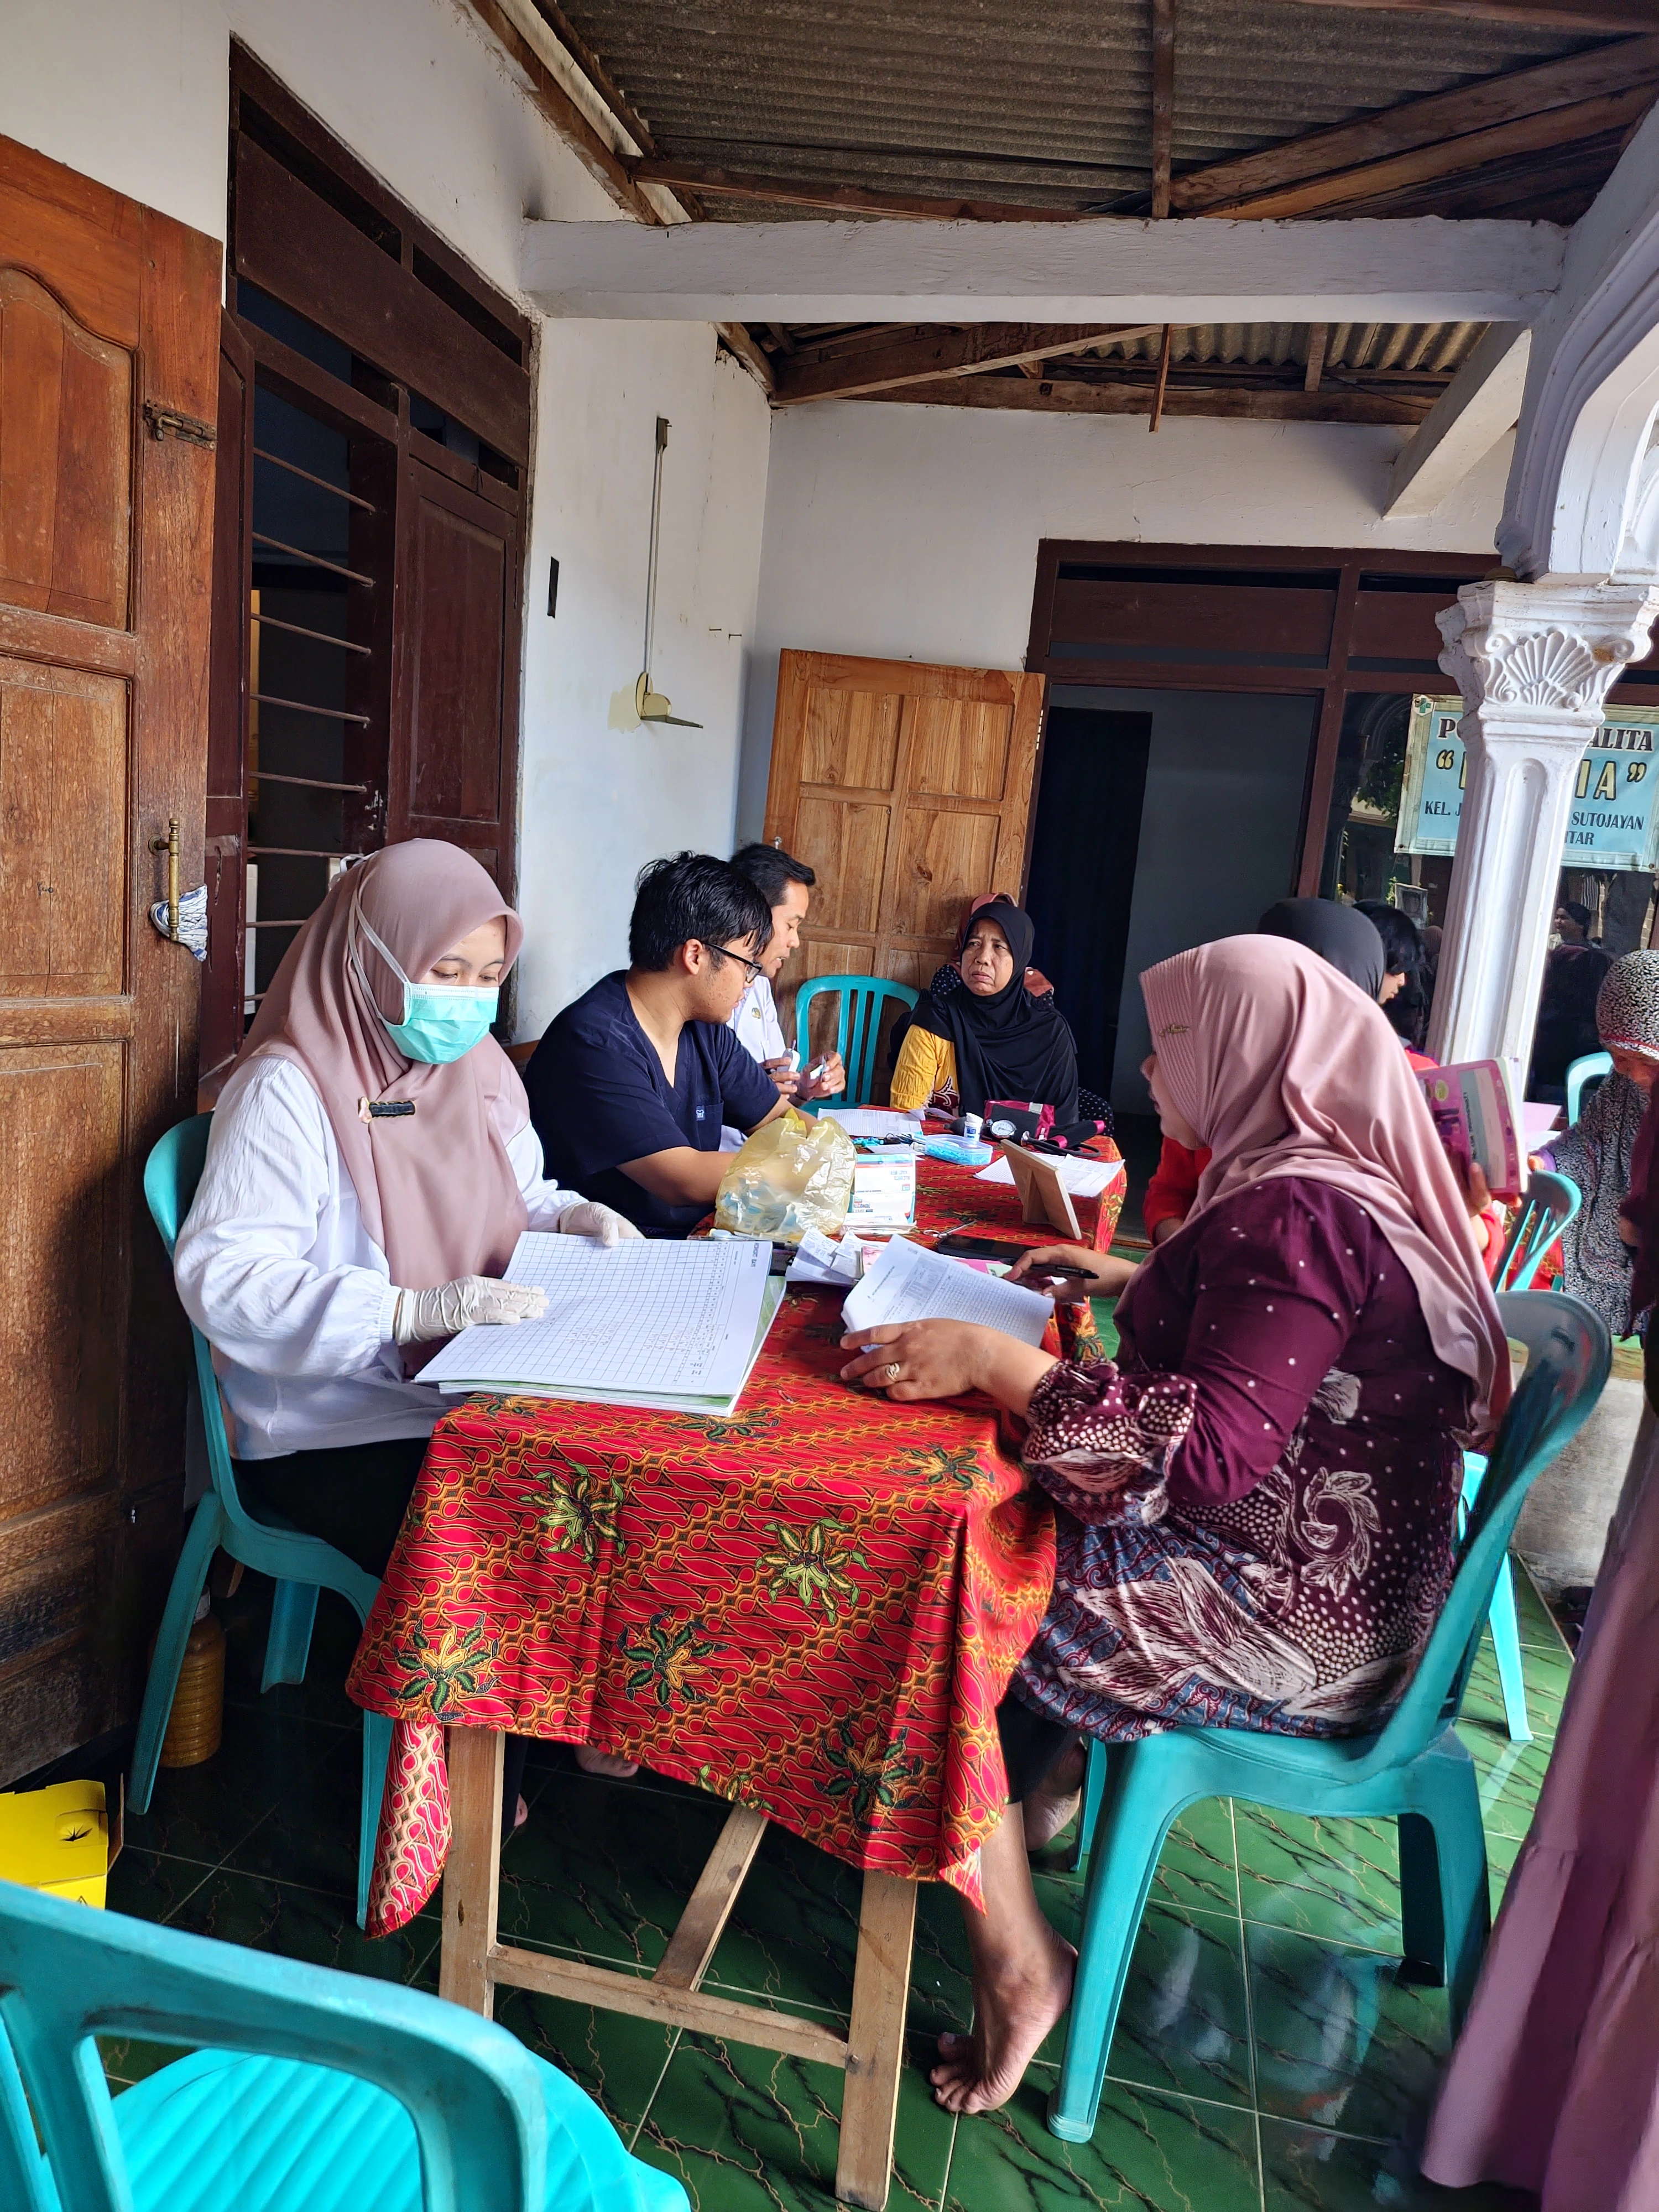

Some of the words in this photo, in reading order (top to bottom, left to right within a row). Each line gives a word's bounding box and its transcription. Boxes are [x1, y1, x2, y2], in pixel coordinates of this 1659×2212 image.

[1589, 727, 1652, 752] ALITA
[1425, 801, 1451, 816] KEL.
[1572, 811, 1645, 831] SUTOJAYAN
[1564, 831, 1594, 846] ITAR
